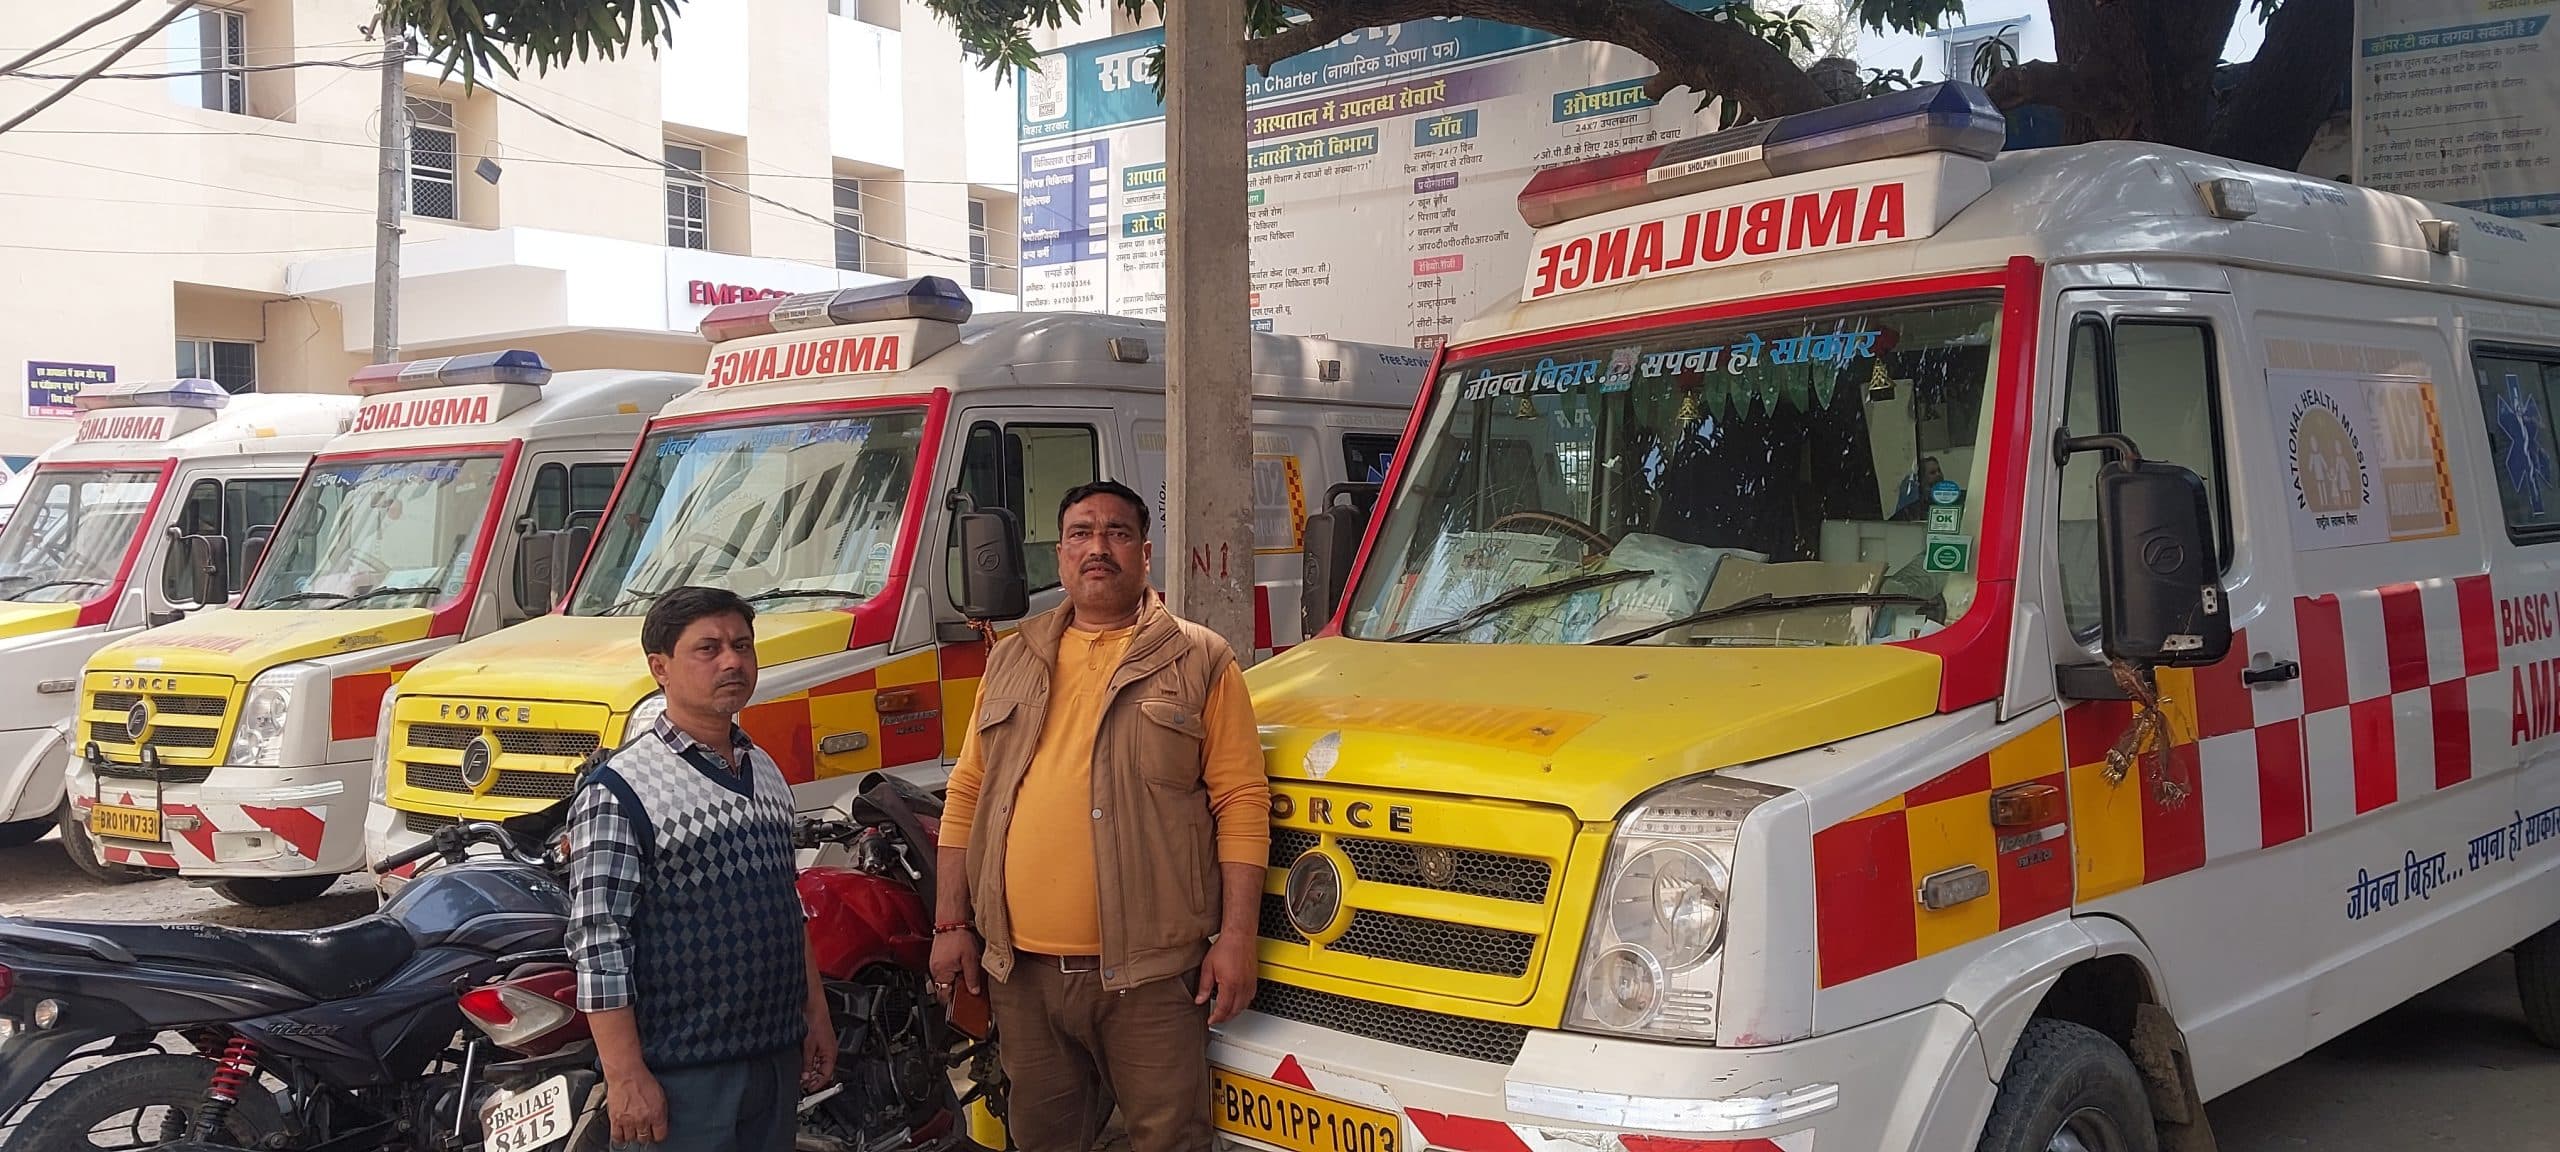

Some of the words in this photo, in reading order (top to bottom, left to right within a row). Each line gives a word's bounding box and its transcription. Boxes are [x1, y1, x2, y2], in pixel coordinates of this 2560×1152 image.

[2418, 34, 2438, 47] कब
[2442, 30, 2474, 44] लगवा
[2477, 23, 2513, 38] सकती
[2516, 21, 2525, 35] है
[1322, 55, 1380, 84] (नागरिक
[1384, 47, 1427, 68] घोषणा
[1432, 37, 1460, 59] पत्र)
[1264, 71, 1317, 91] Charter
[1253, 107, 1318, 135] अस्पताल
[1322, 101, 1335, 122] में
[1340, 94, 1395, 120] उपलब्ध
[1429, 115, 1463, 138] जाँच
[1600, 114, 1638, 128] उपलब्धता
[1023, 121, 1042, 136] बिहार
[1044, 120, 1070, 133] सरकार
[1295, 139, 1325, 161] रोगी
[1328, 134, 1374, 155] विभाग
[1460, 142, 1473, 152] दिन
[1584, 140, 1600, 153] लिए
[1603, 138, 1619, 149] 285
[1622, 134, 1644, 146] प्रकार
[1646, 130, 1657, 142] की
[1379, 353, 1401, 365] Free
[1463, 368, 1528, 401] जीवन्त
[1640, 346, 1722, 379] सपना
[1730, 333, 1763, 375] हो
[1770, 330, 1882, 366] साकार
[2288, 403, 2307, 511] NATIONAL
[2300, 388, 2339, 418] HEALTH
[2341, 412, 2370, 505] MISSION
[2500, 592, 2553, 647] BASIC
[112, 675, 177, 691] FORCE
[440, 704, 530, 723] FORCE
[1270, 793, 1413, 833] ORCE
[2346, 867, 2400, 920] जीवन्त
[2468, 826, 2506, 872] सपना
[2509, 809, 2523, 862] हो
[1225, 1083, 1395, 1152] BR01PP1003
[496, 1110, 555, 1152] 8415
